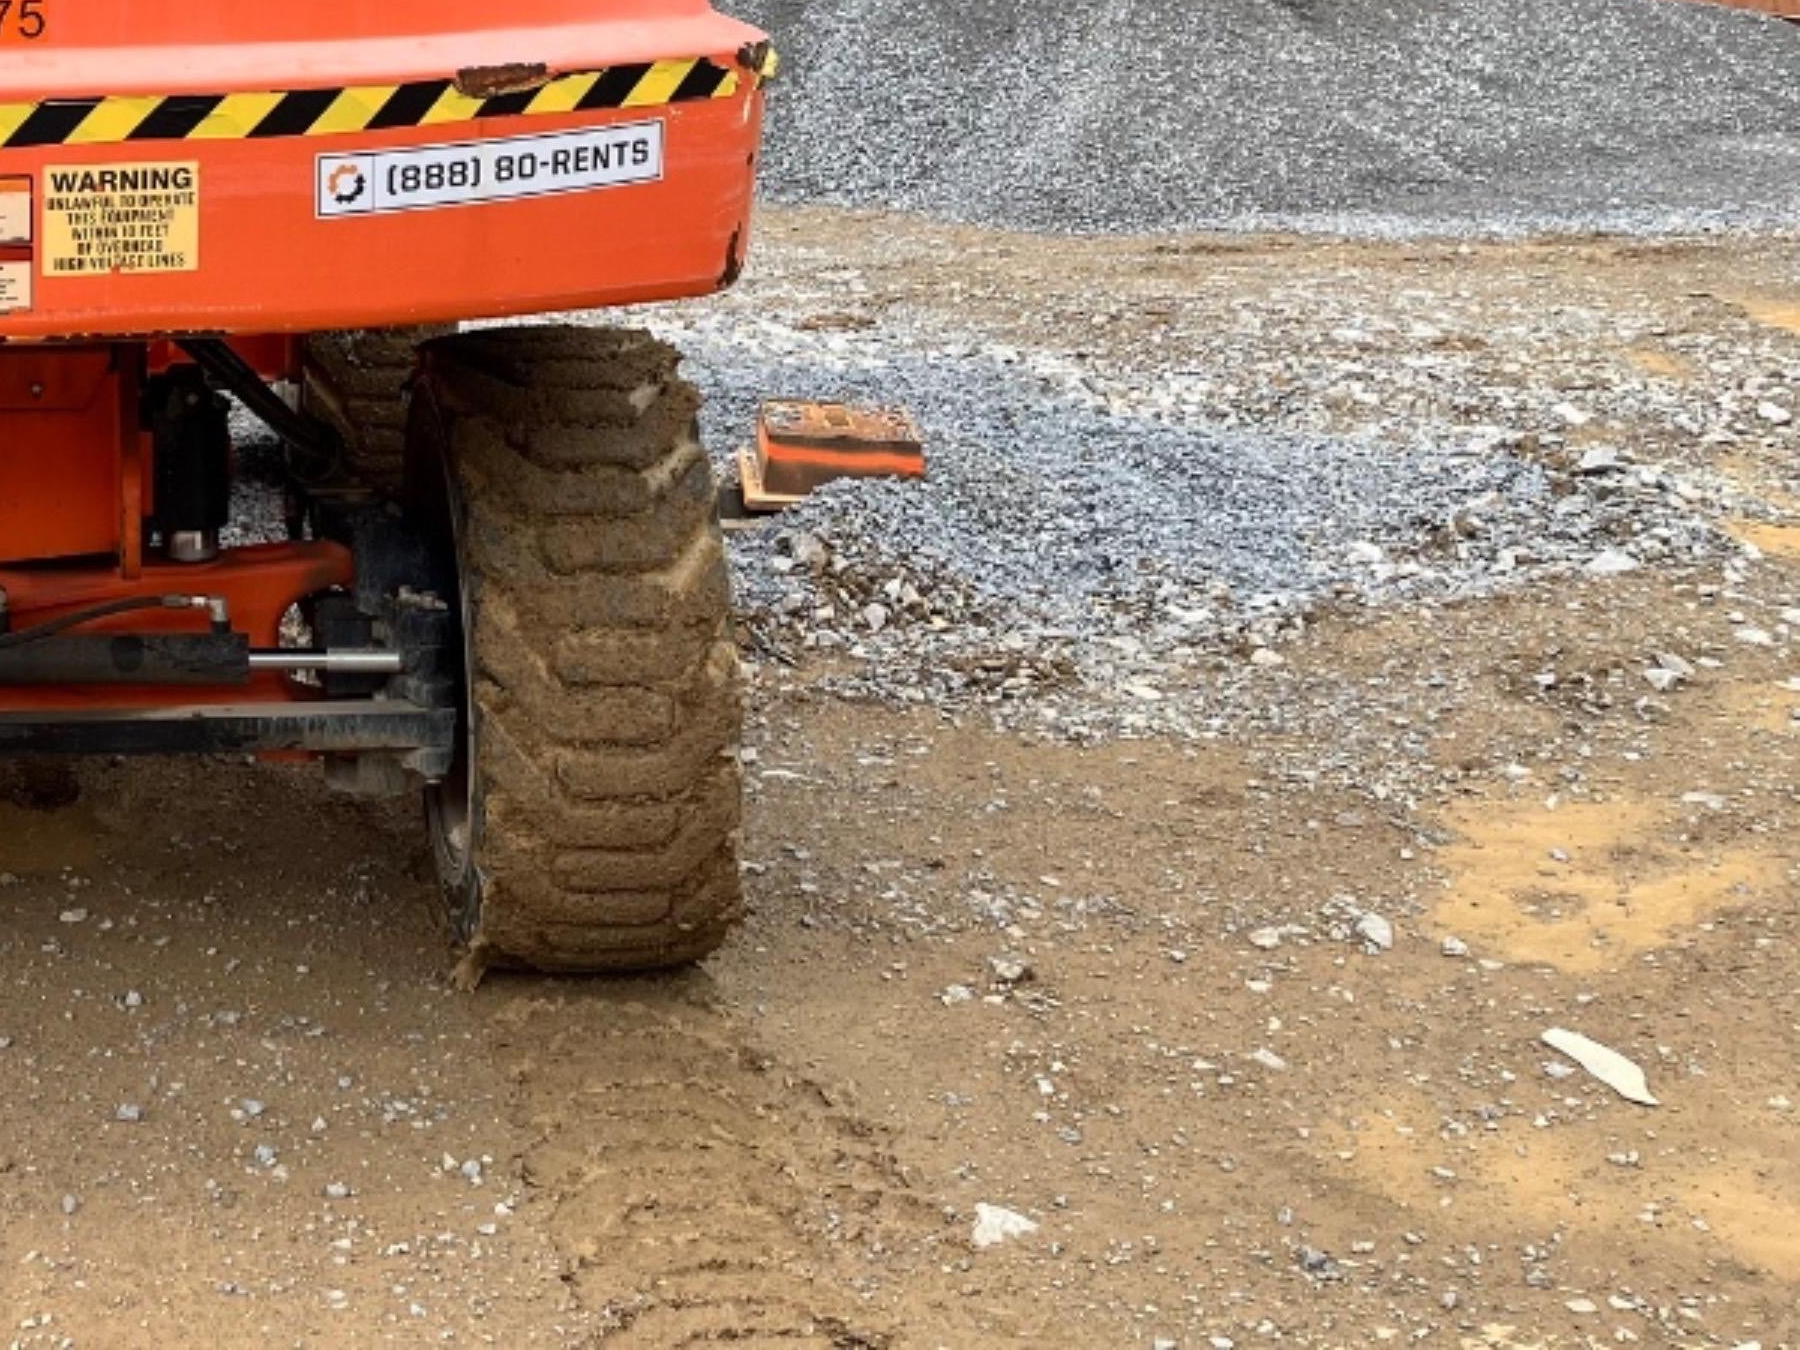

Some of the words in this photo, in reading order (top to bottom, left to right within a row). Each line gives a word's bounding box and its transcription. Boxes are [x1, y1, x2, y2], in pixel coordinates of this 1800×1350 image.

[50, 167, 193, 193] WARNING
[386, 158, 482, 195] (888)
[493, 138, 650, 181] 80-RENTS
